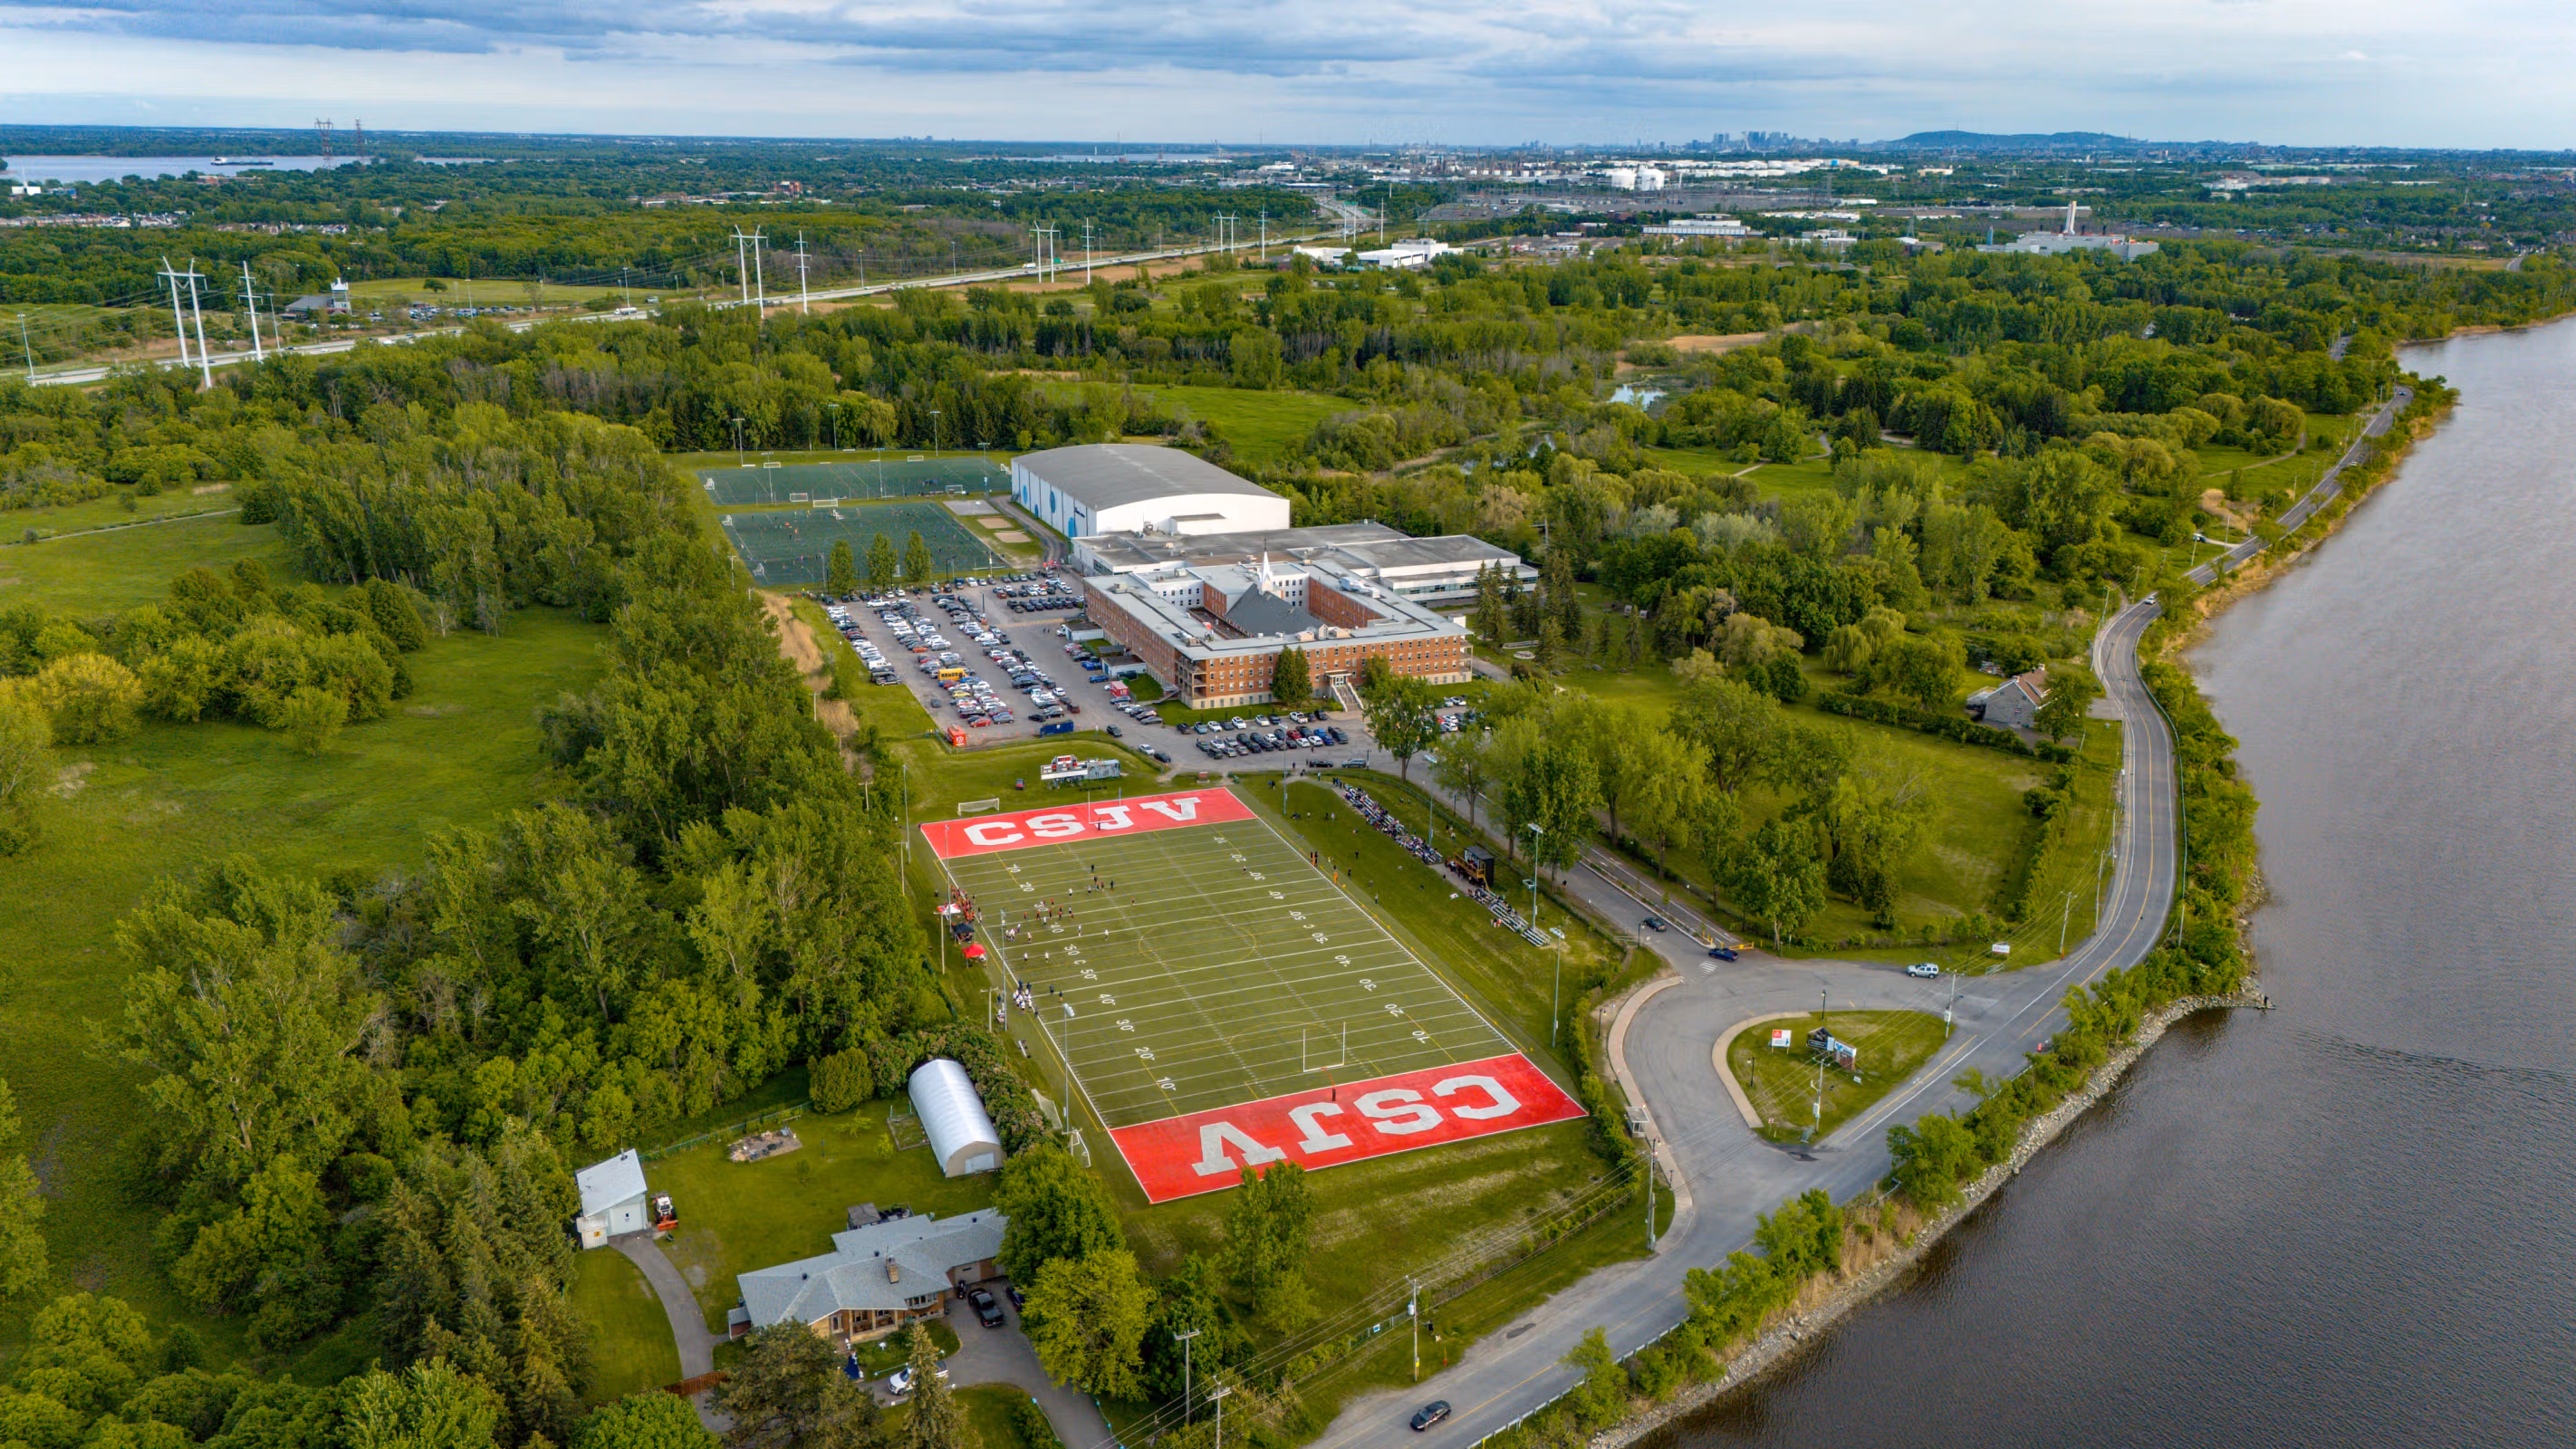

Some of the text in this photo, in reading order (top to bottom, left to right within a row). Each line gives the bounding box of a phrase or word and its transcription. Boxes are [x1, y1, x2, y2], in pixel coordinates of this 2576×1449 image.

[963, 796, 1201, 846] CSJV
[1250, 872, 1265, 880] 30
[1290, 911, 1306, 921] 50
[1312, 933, 1328, 943] 50
[1064, 945, 1081, 955] 50
[1081, 968, 1097, 979] 50
[1359, 978, 1377, 990] 30
[1099, 994, 1115, 1004] 40
[1384, 1003, 1404, 1015] 20
[1116, 1019, 1134, 1031] 30
[1412, 1031, 1429, 1041] 10
[1134, 1047, 1154, 1059] 20
[1157, 1078, 1176, 1089] 10
[1191, 1074, 1522, 1176] CSJV
